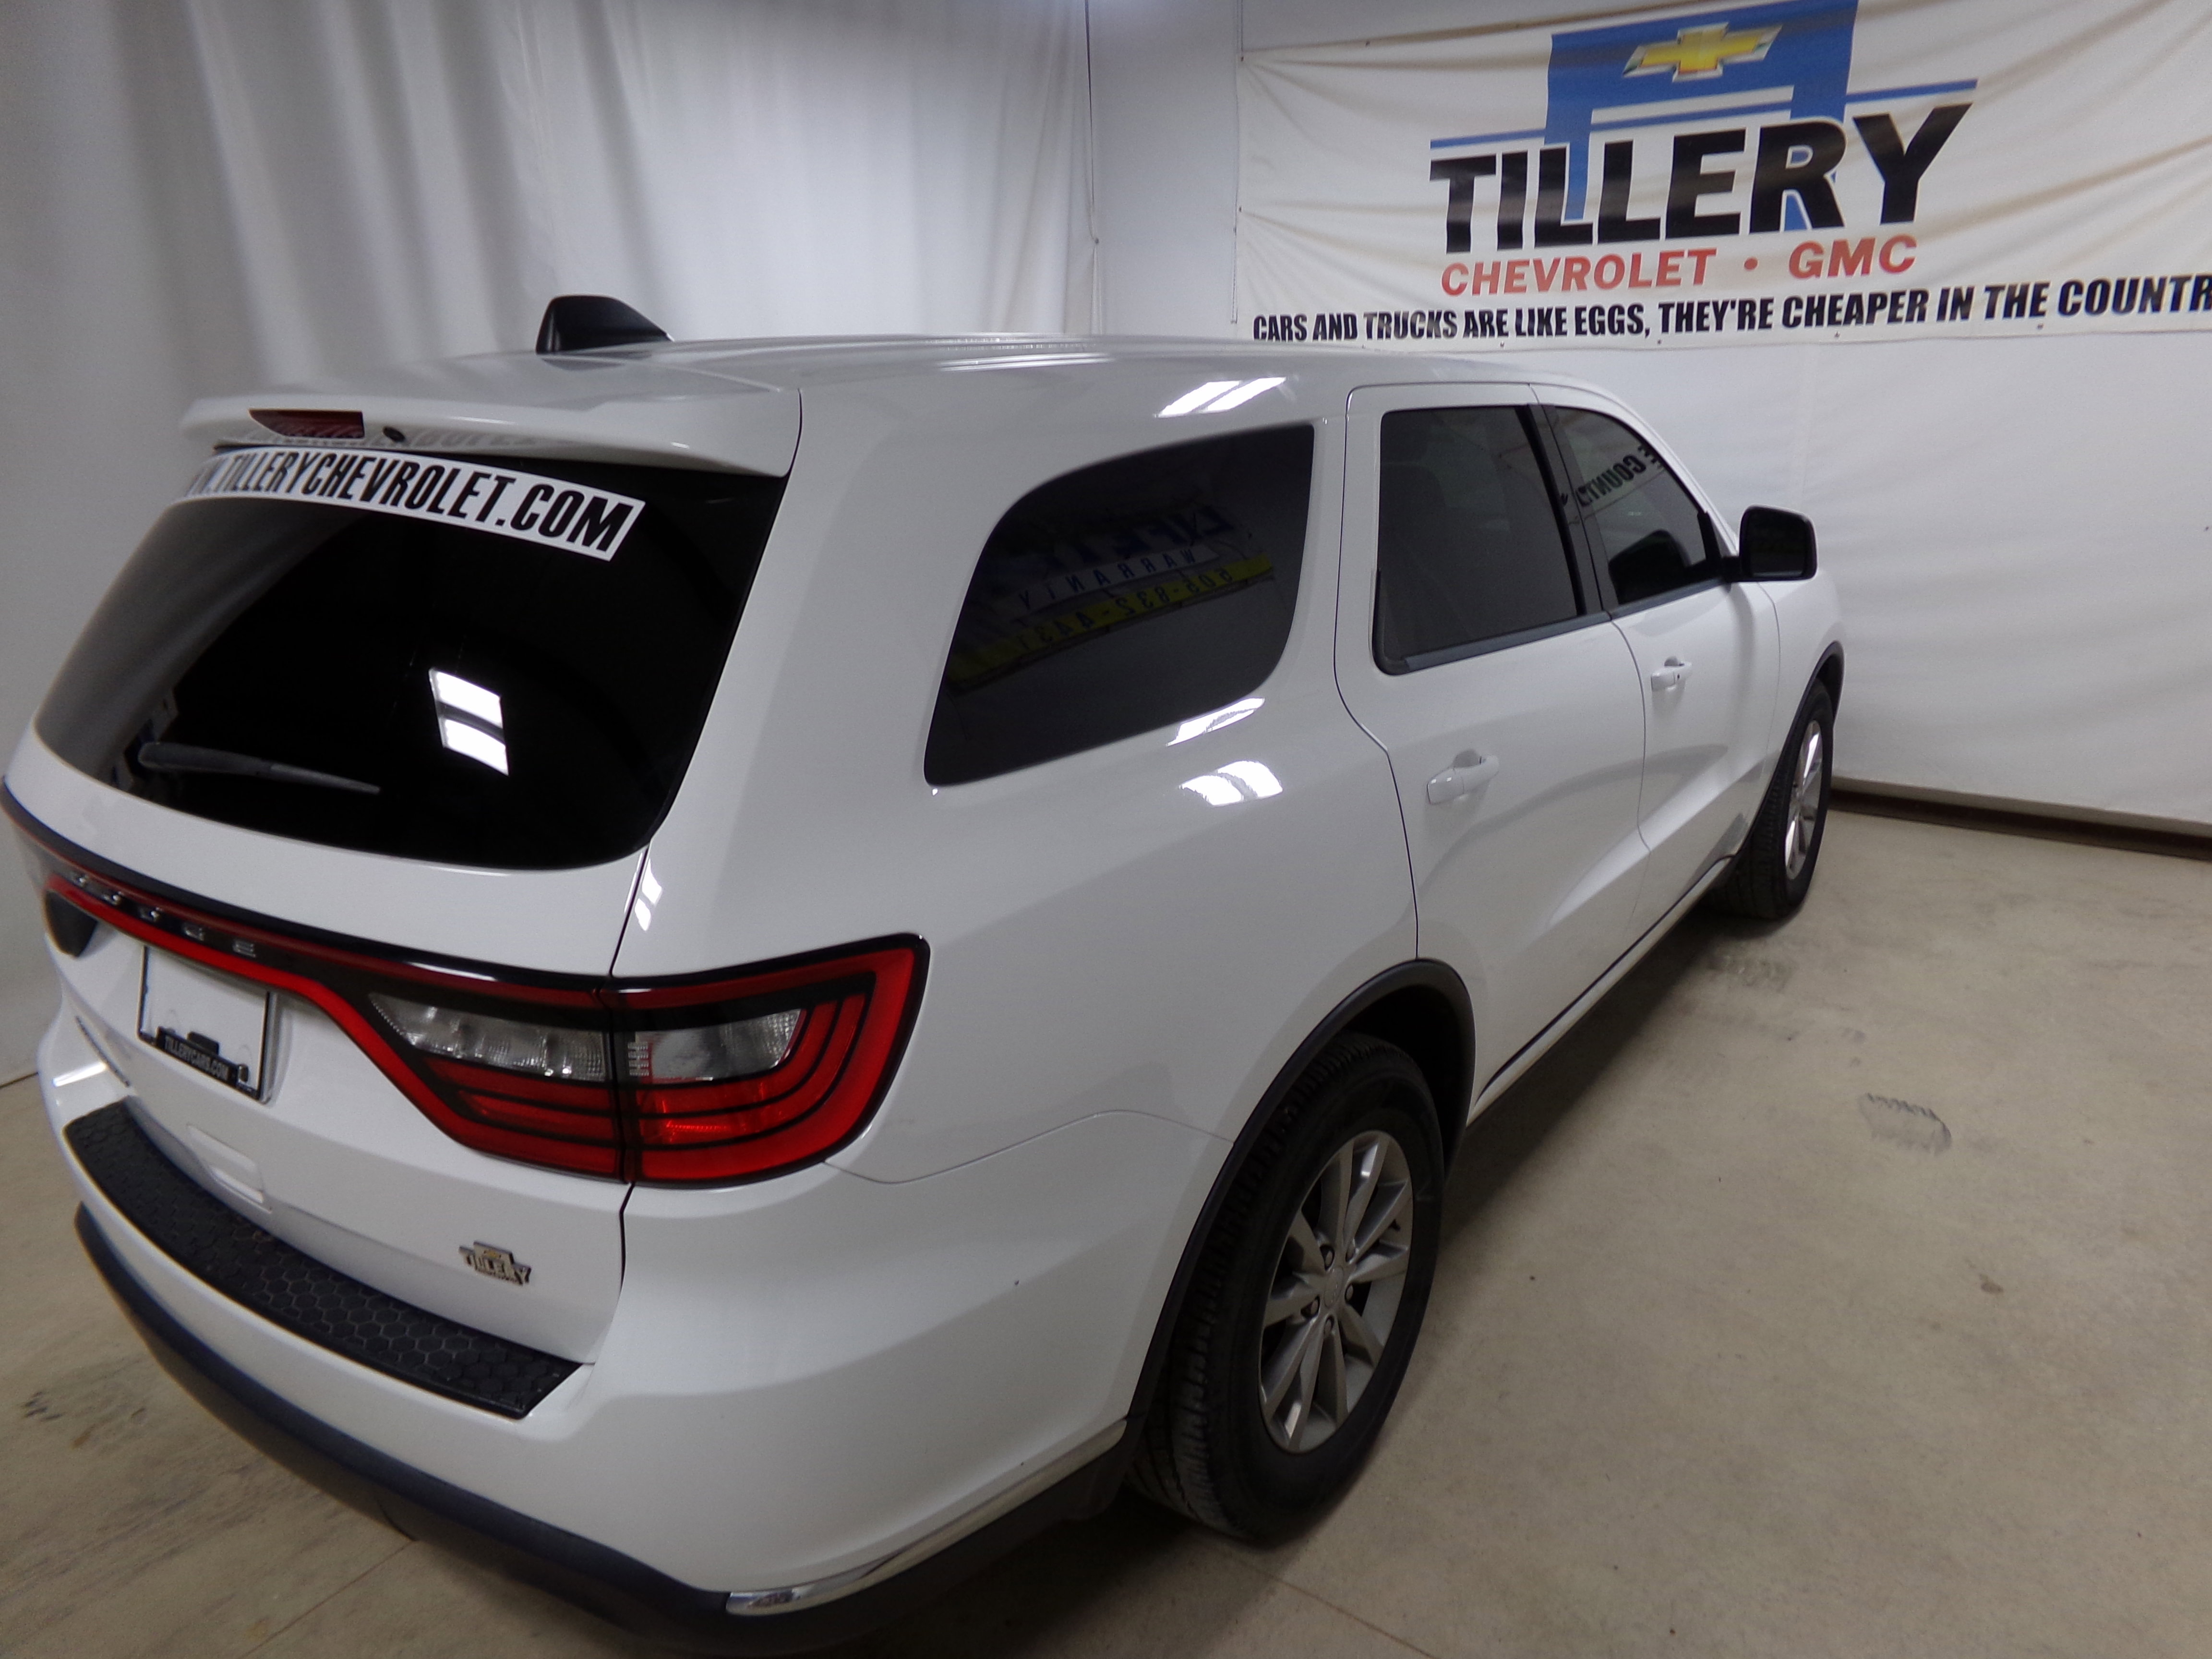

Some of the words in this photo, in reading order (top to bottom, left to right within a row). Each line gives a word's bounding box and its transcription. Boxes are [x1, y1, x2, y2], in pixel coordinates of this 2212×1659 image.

[1429, 102, 1973, 255] TILLERY
[1441, 247, 1717, 297] CHEVROLET
[1788, 233, 1917, 280] GMC
[1253, 313, 1308, 341] CARS
[1312, 311, 1358, 340] AND
[1362, 310, 1458, 340] TRUCKS
[1464, 308, 1509, 339] ARE
[1515, 305, 1568, 338] LIKE
[1574, 303, 1650, 338] EGGS,
[1658, 297, 1774, 333] THEY'RE
[1781, 289, 1929, 328] CHEAPER
[1936, 286, 1975, 322] IN
[1984, 281, 2051, 320] THE
